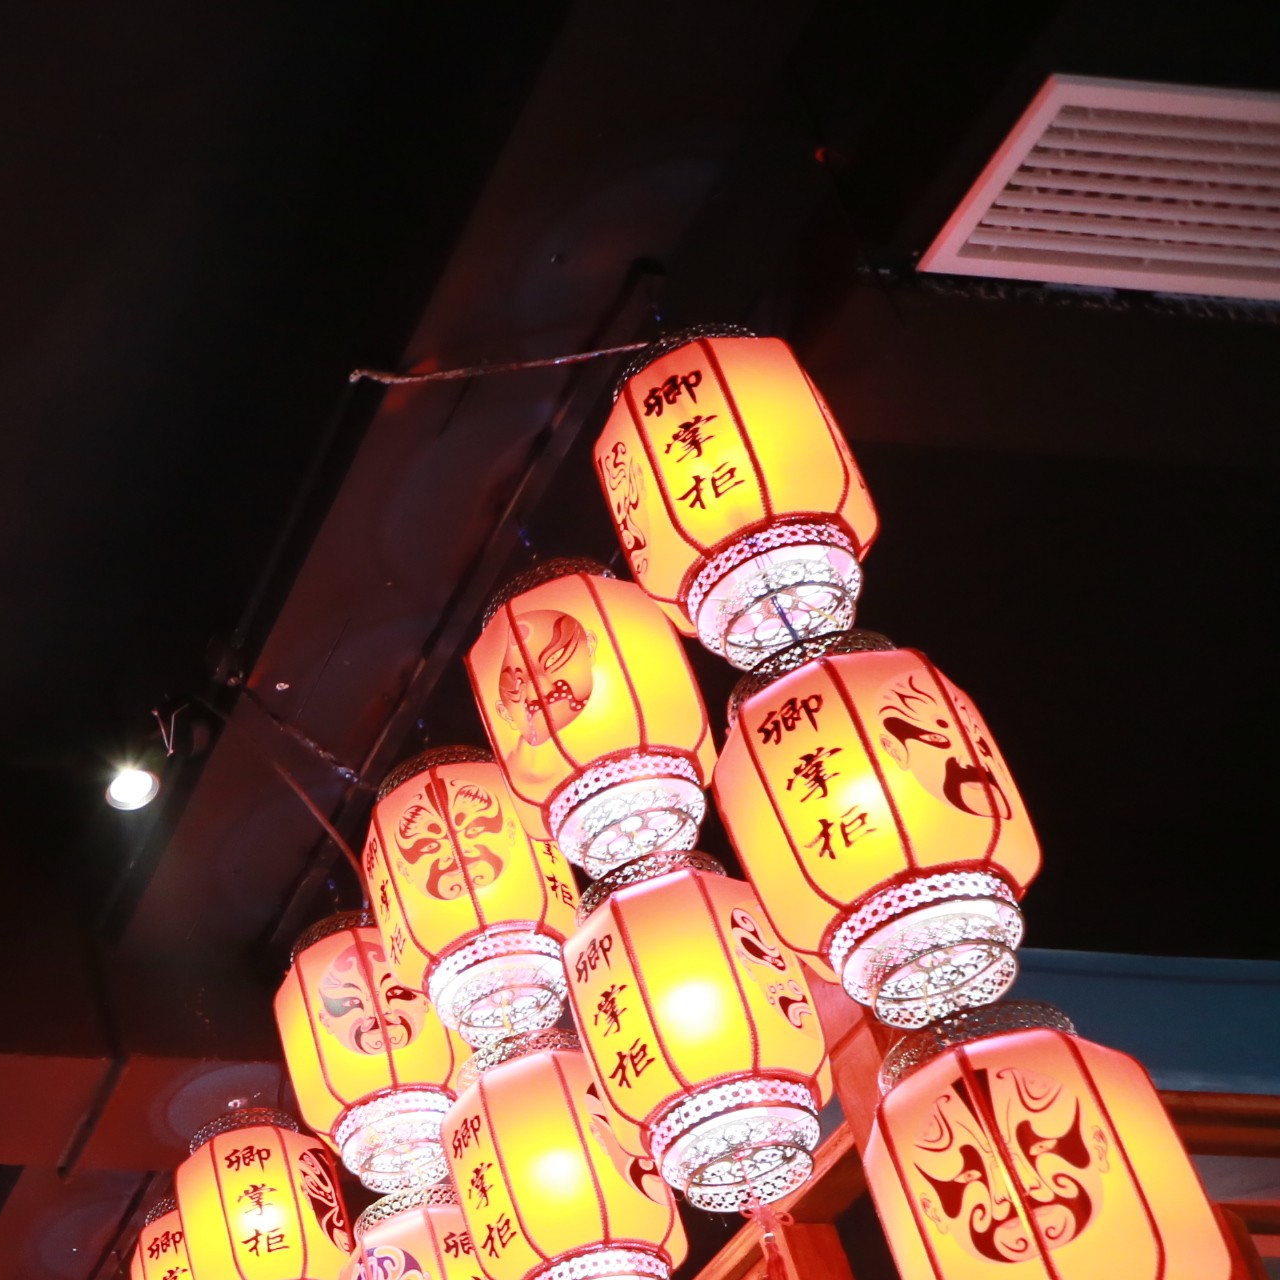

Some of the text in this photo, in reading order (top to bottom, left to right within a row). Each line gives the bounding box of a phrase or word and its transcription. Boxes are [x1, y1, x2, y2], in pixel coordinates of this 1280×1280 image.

[643, 368, 745, 510] 卿掌柜
[756, 693, 877, 861] 卿掌柜
[575, 933, 656, 1090] 卿掌柜
[224, 1144, 290, 1257] 卿掌柜
[452, 1114, 517, 1259] 卿掌柜
